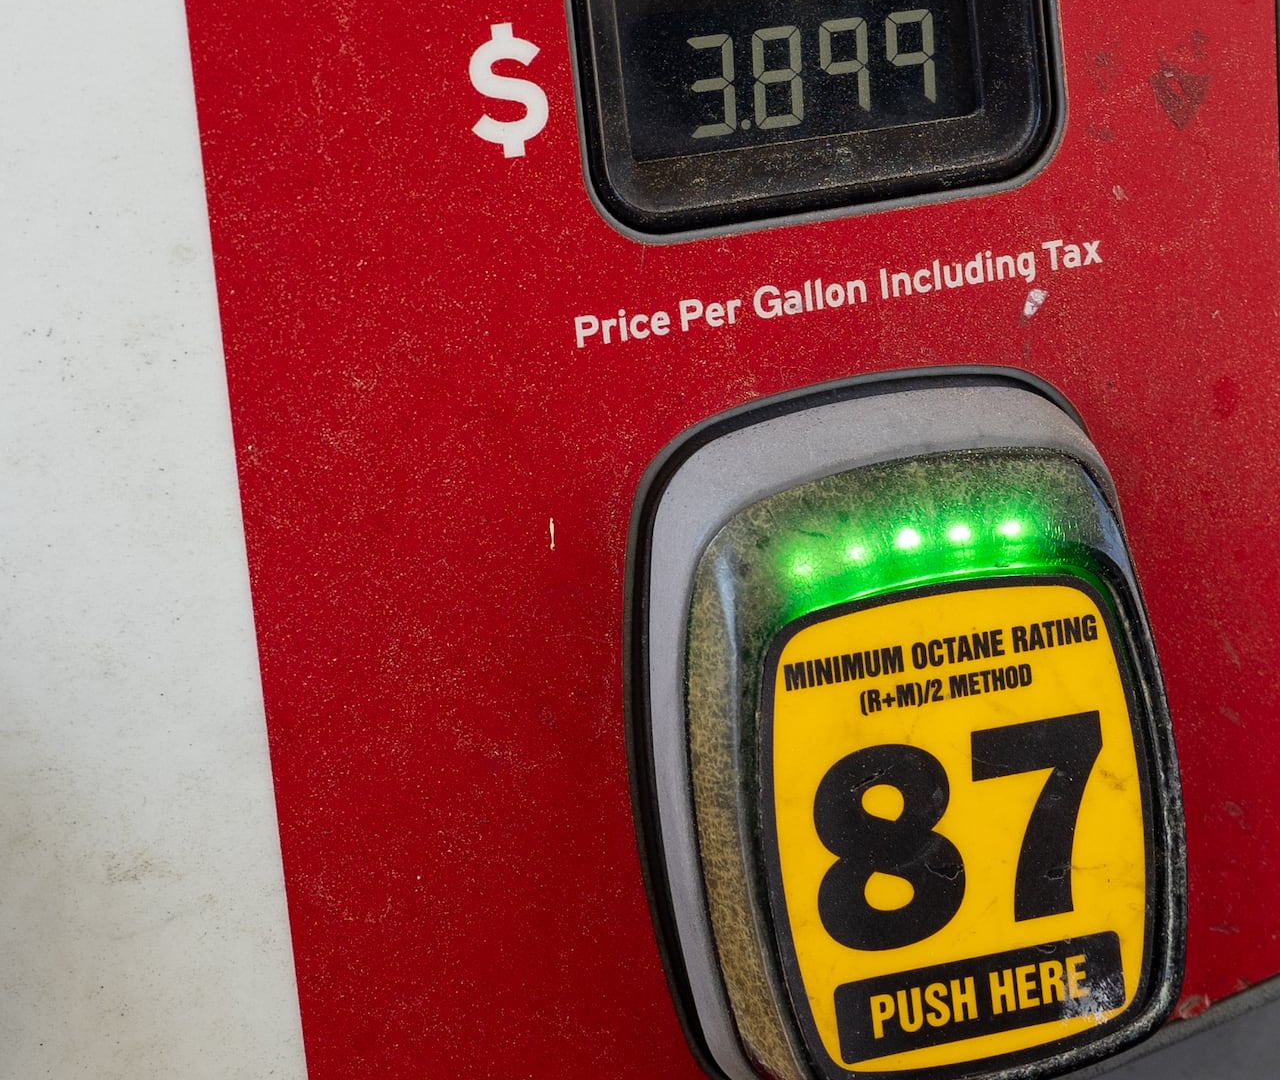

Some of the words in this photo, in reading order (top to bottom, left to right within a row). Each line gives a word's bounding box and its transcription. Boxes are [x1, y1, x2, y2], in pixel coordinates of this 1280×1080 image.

[468, 22, 549, 158] $
[687, 8, 936, 139] 3.899
[574, 307, 671, 348] Price
[679, 294, 742, 332] Per
[752, 274, 867, 318] Gallon
[879, 243, 1036, 299] Including
[1041, 236, 1103, 271] Tax
[784, 646, 904, 691] MINIMUM
[912, 631, 1004, 667] OCTANE
[1012, 614, 1098, 652] RATING
[860, 679, 944, 716] (R+M)/2
[949, 663, 1033, 700] METHOD
[813, 711, 1103, 951] 87
[869, 977, 976, 1039] PUSH
[990, 955, 1089, 1022] HERE
